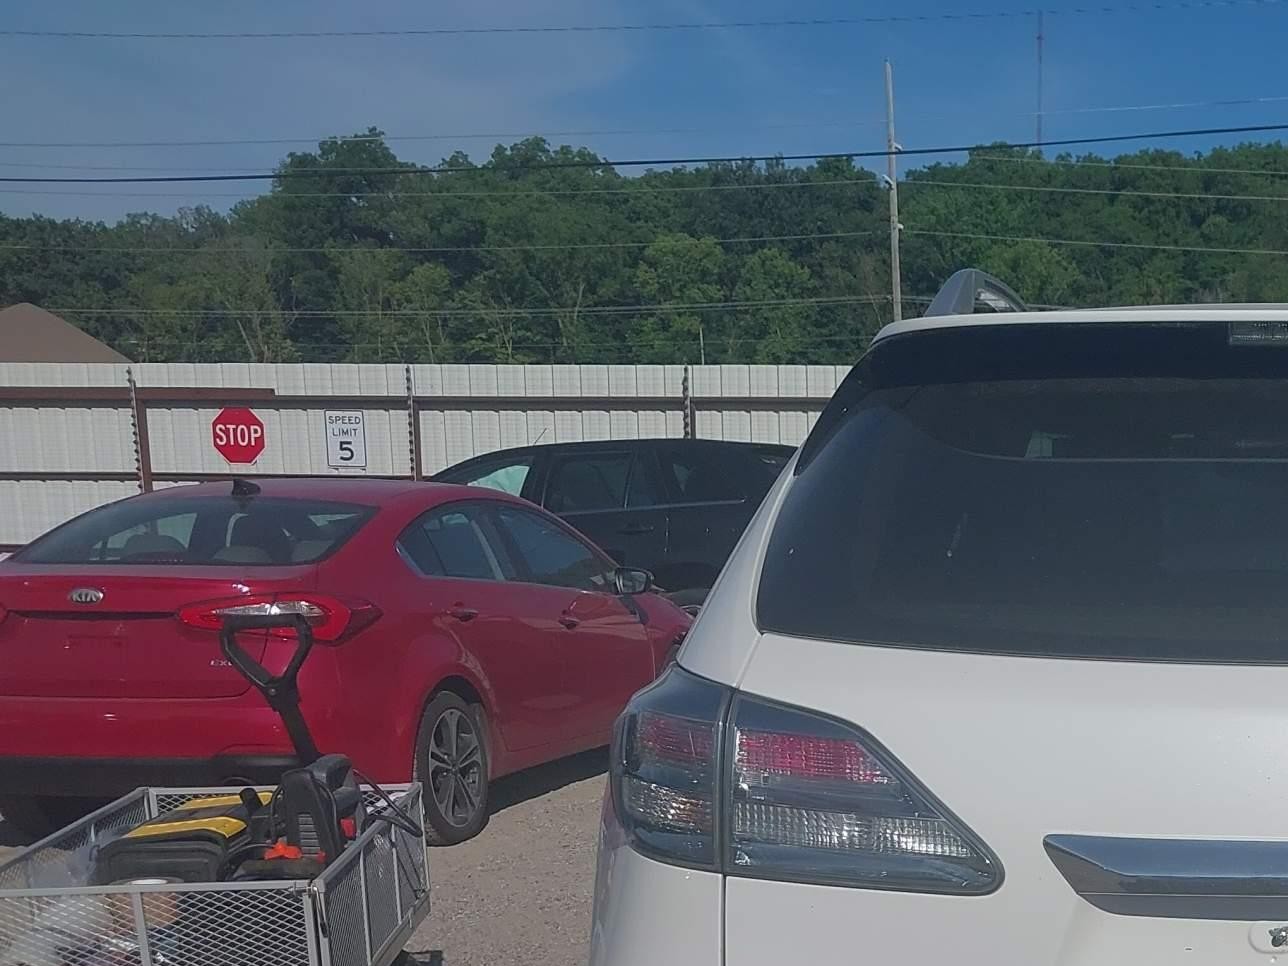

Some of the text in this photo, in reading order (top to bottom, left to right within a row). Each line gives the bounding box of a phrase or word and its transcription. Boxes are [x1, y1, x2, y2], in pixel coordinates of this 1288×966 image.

[328, 415, 361, 425] SPEED
[215, 424, 262, 447] STOP
[332, 427, 358, 437] LIMIT
[339, 440, 355, 461] 5
